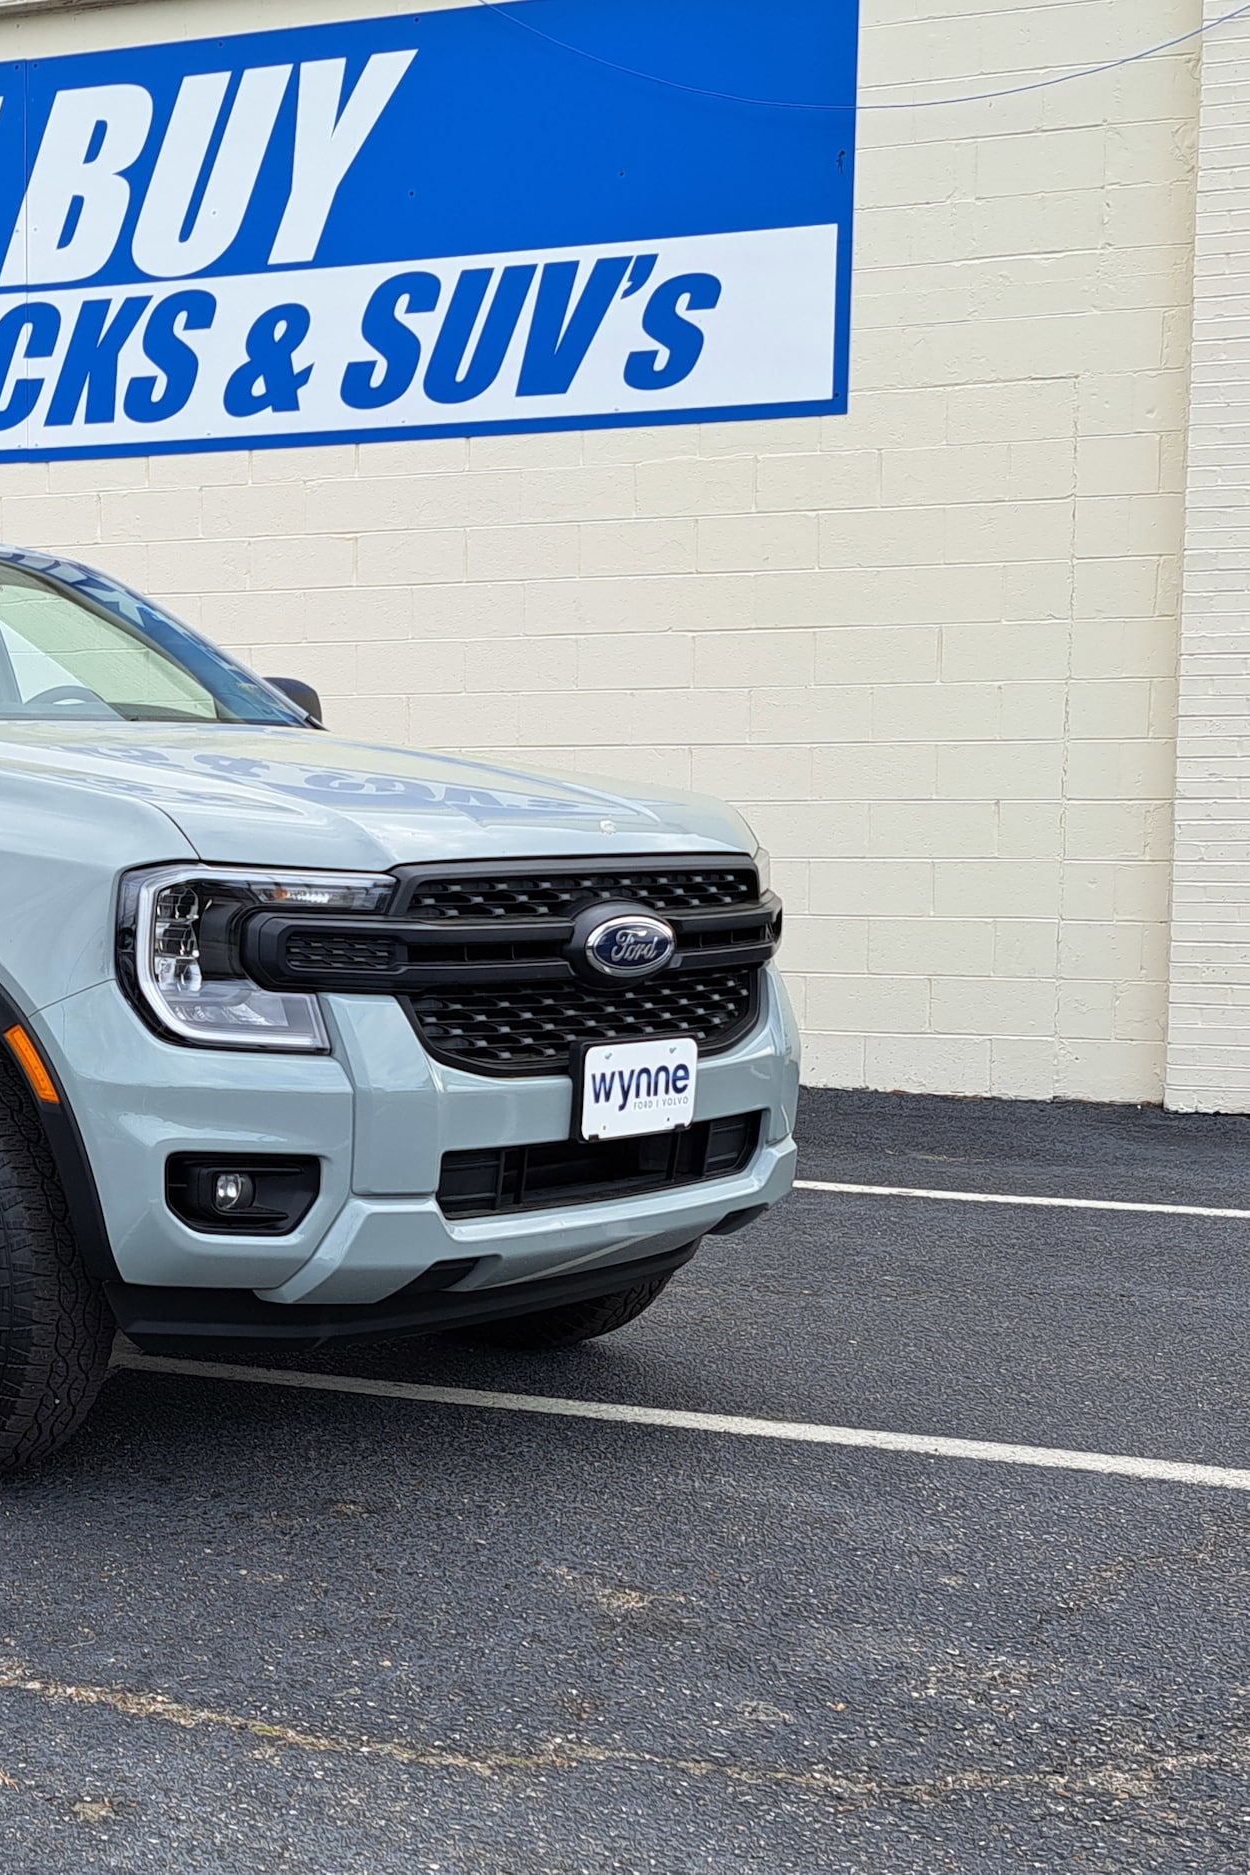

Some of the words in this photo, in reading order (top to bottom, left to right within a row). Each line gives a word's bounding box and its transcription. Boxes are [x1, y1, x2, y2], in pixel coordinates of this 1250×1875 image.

[223, 303, 315, 418] &
[340, 253, 723, 410] SUV'S
[611, 929, 658, 961] Ford
[591, 1063, 690, 1112] wynne
[633, 1100, 653, 1111] FORD
[662, 1095, 689, 1108] VOLVO
